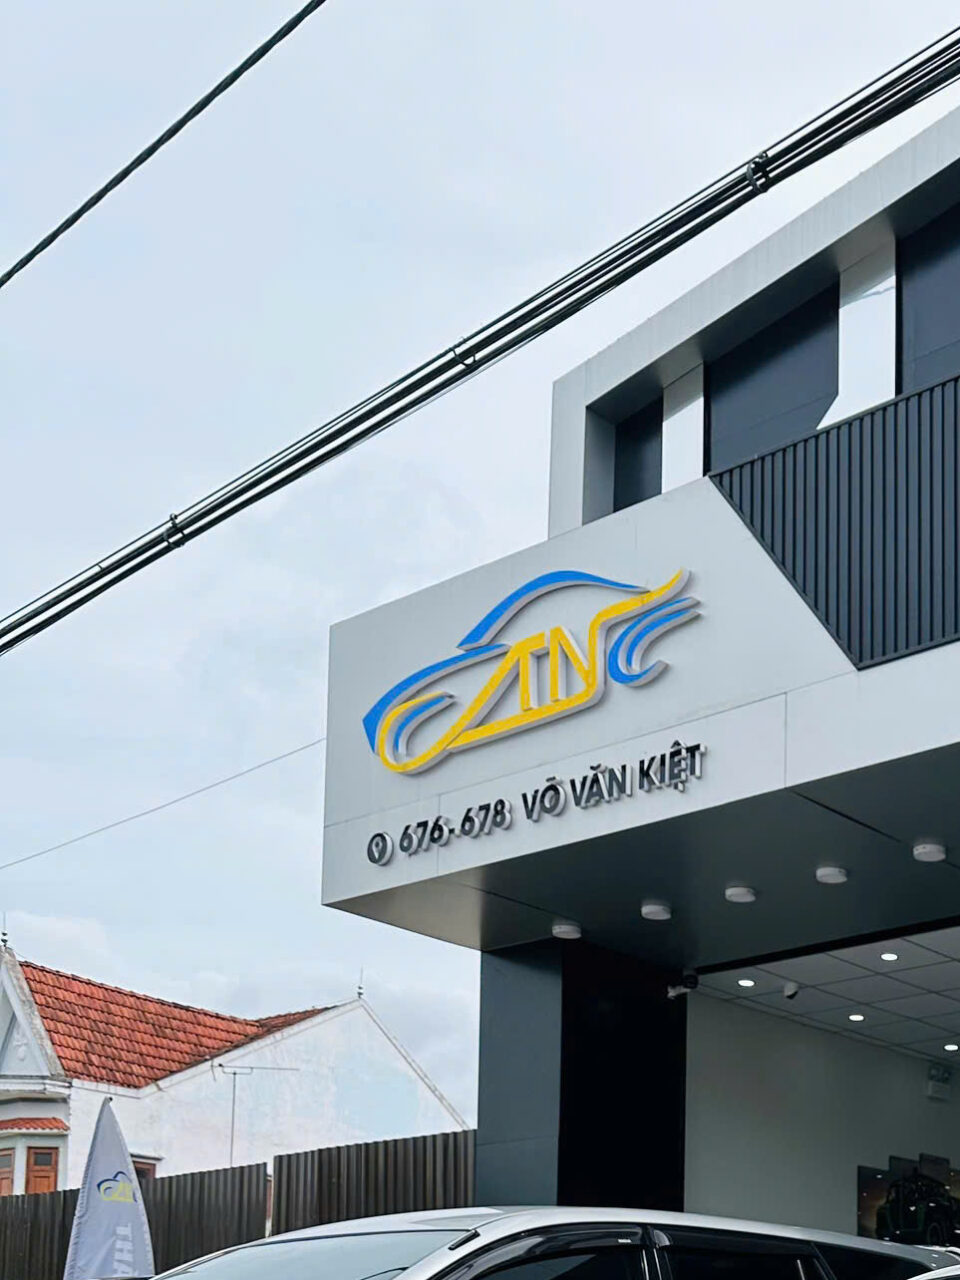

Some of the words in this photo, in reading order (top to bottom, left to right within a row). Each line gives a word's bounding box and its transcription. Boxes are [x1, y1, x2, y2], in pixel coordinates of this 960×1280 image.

[521, 776, 567, 822] VÕ
[569, 763, 633, 809] VĂN
[638, 740, 707, 792] KIỆT
